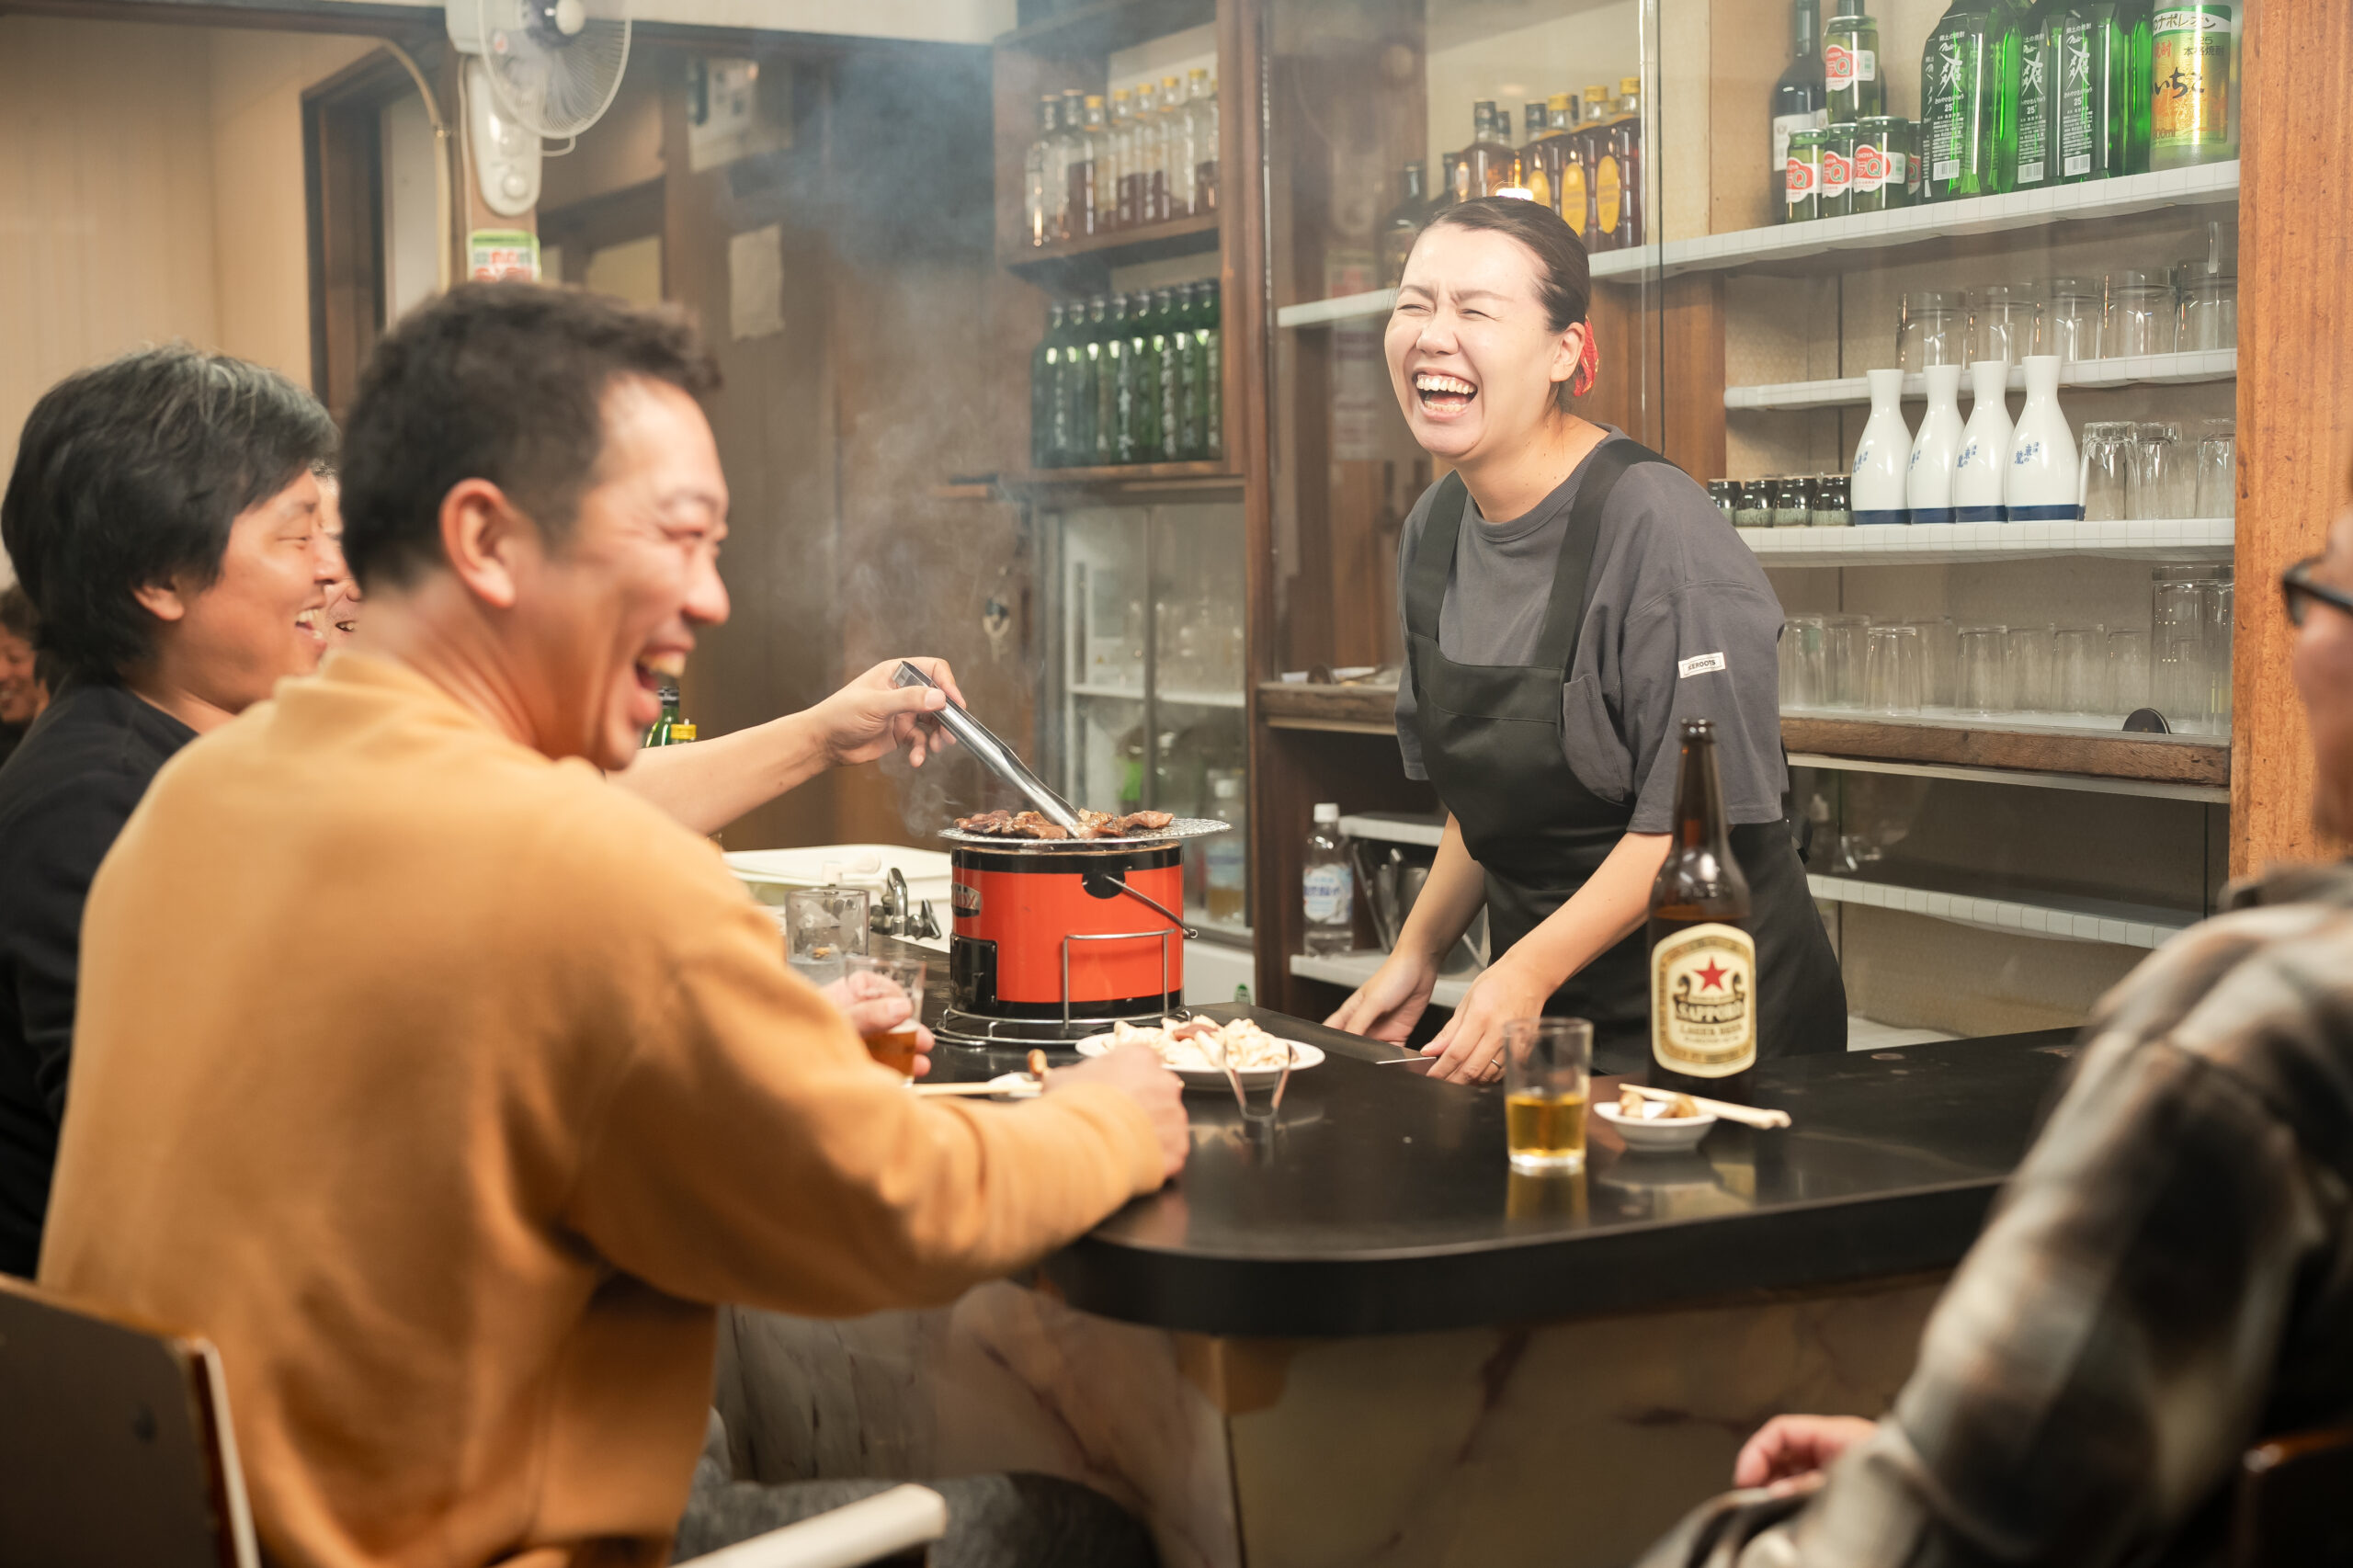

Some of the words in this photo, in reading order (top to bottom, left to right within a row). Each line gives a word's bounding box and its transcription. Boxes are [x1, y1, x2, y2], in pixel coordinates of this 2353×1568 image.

[1938, 46, 1963, 97] 爽
[2022, 51, 2044, 97] 爽
[2066, 41, 2090, 91] 爽
[2154, 67, 2204, 98] いちこ
[1677, 1000, 1745, 1022] SAPPORO
